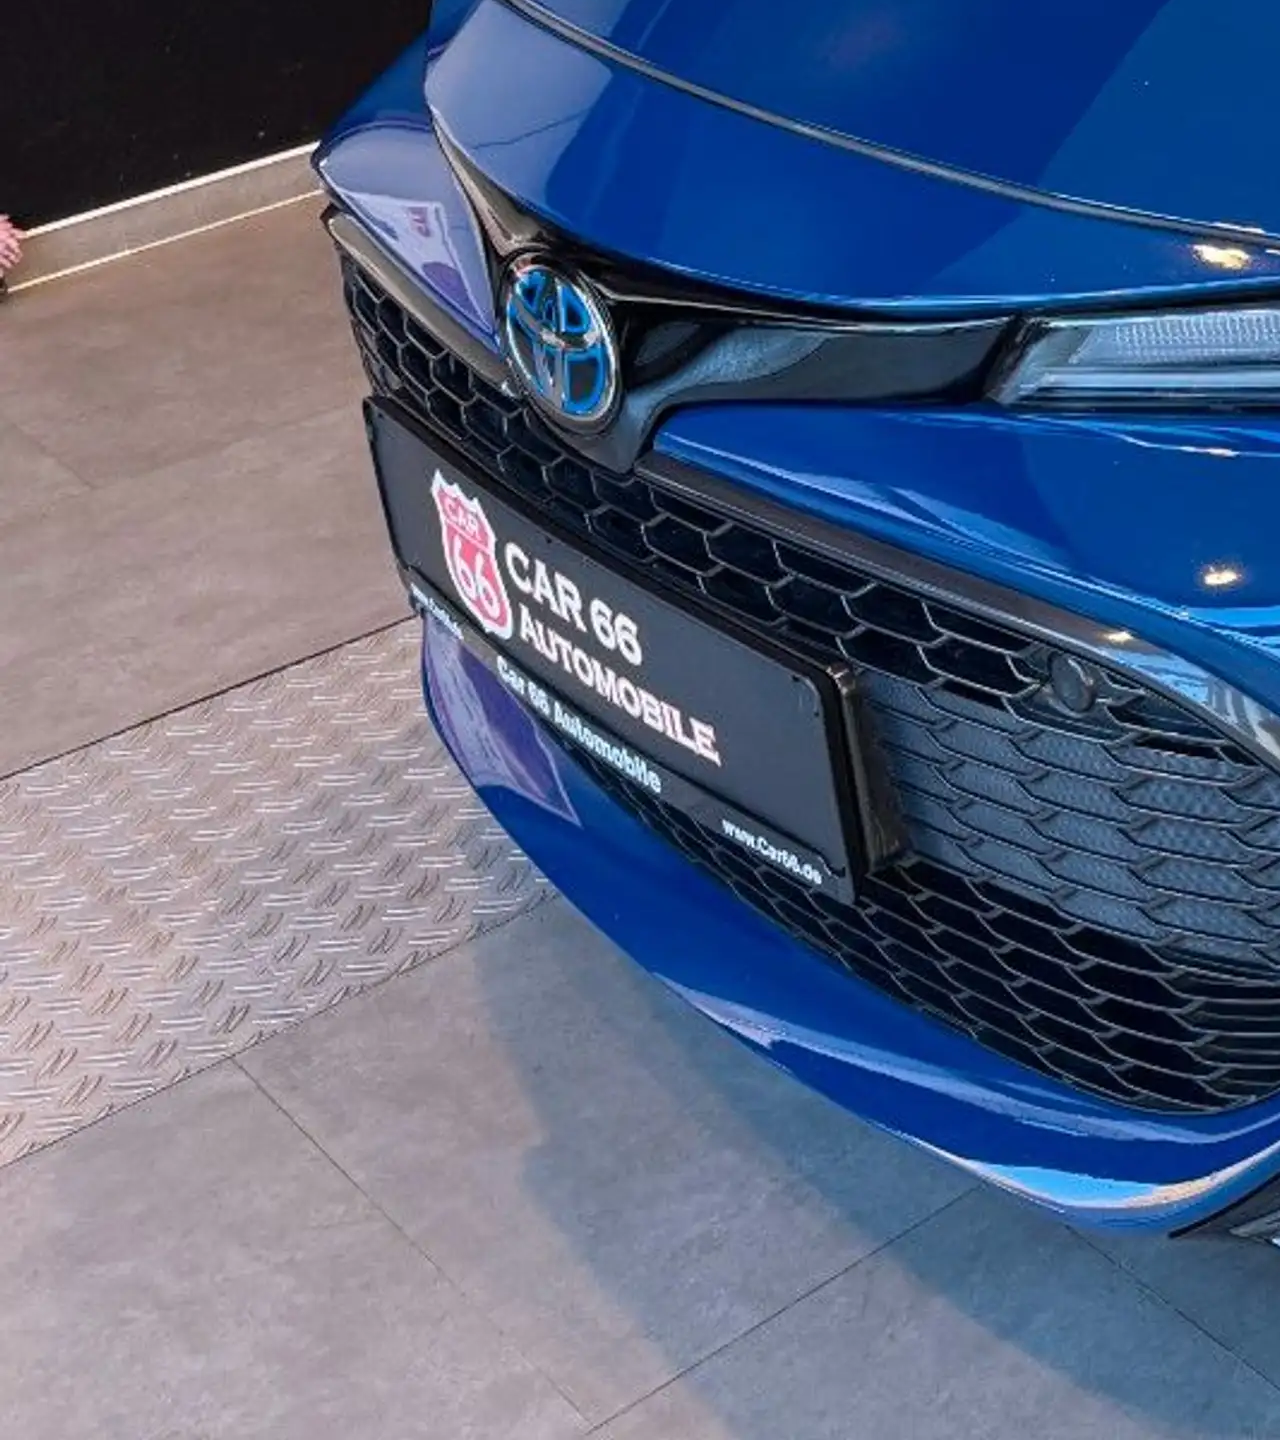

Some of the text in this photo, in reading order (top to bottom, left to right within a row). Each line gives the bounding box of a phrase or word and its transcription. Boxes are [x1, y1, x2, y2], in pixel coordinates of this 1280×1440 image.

[443, 496, 482, 542] CAR
[453, 533, 500, 620] 66
[504, 541, 588, 633] CAR
[590, 598, 643, 666] 66
[518, 602, 723, 768] AUTOMOBILE
